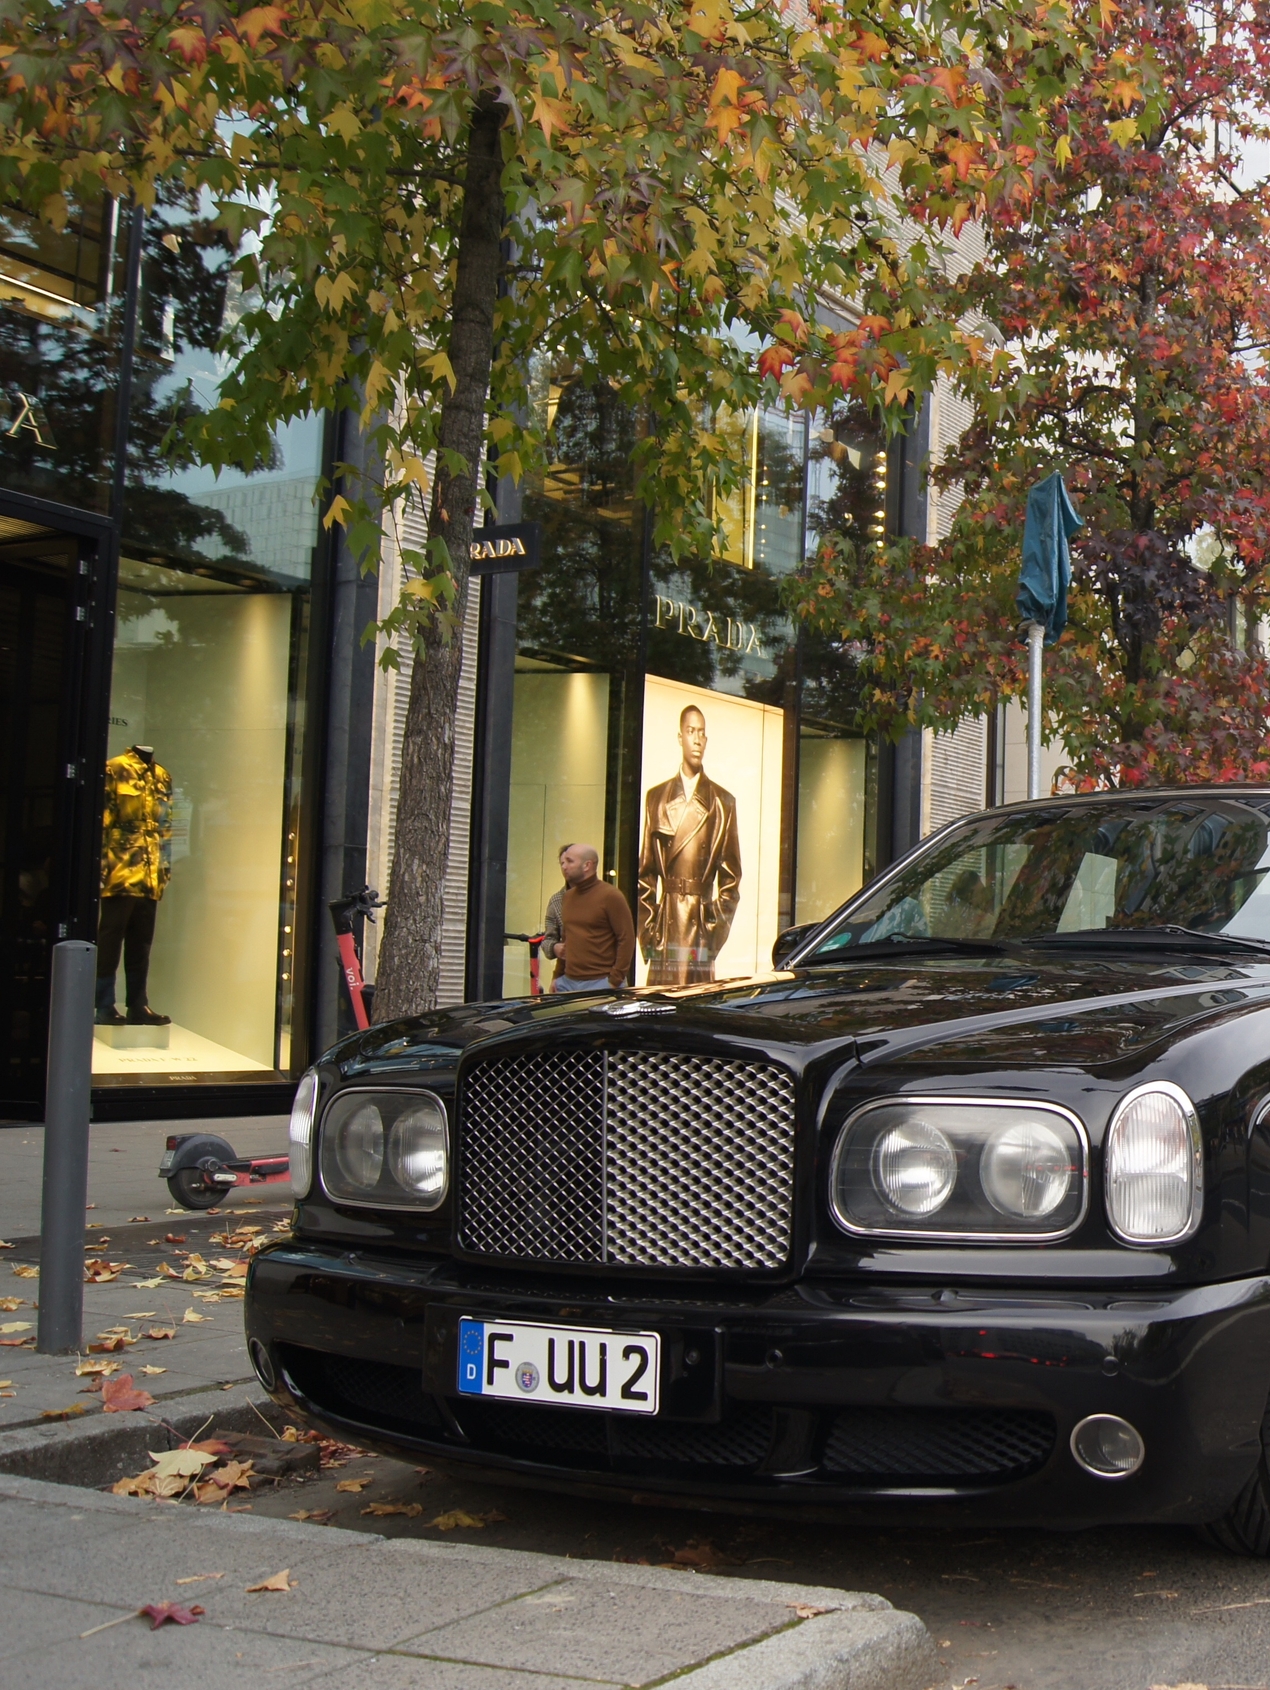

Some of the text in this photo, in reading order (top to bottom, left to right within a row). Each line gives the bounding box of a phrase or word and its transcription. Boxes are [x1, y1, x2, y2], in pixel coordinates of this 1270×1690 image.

[470, 537, 526, 560] RADA
[655, 595, 768, 659] PRADA
[466, 1364, 477, 1380] D
[486, 1332, 649, 1402] F UU 2
